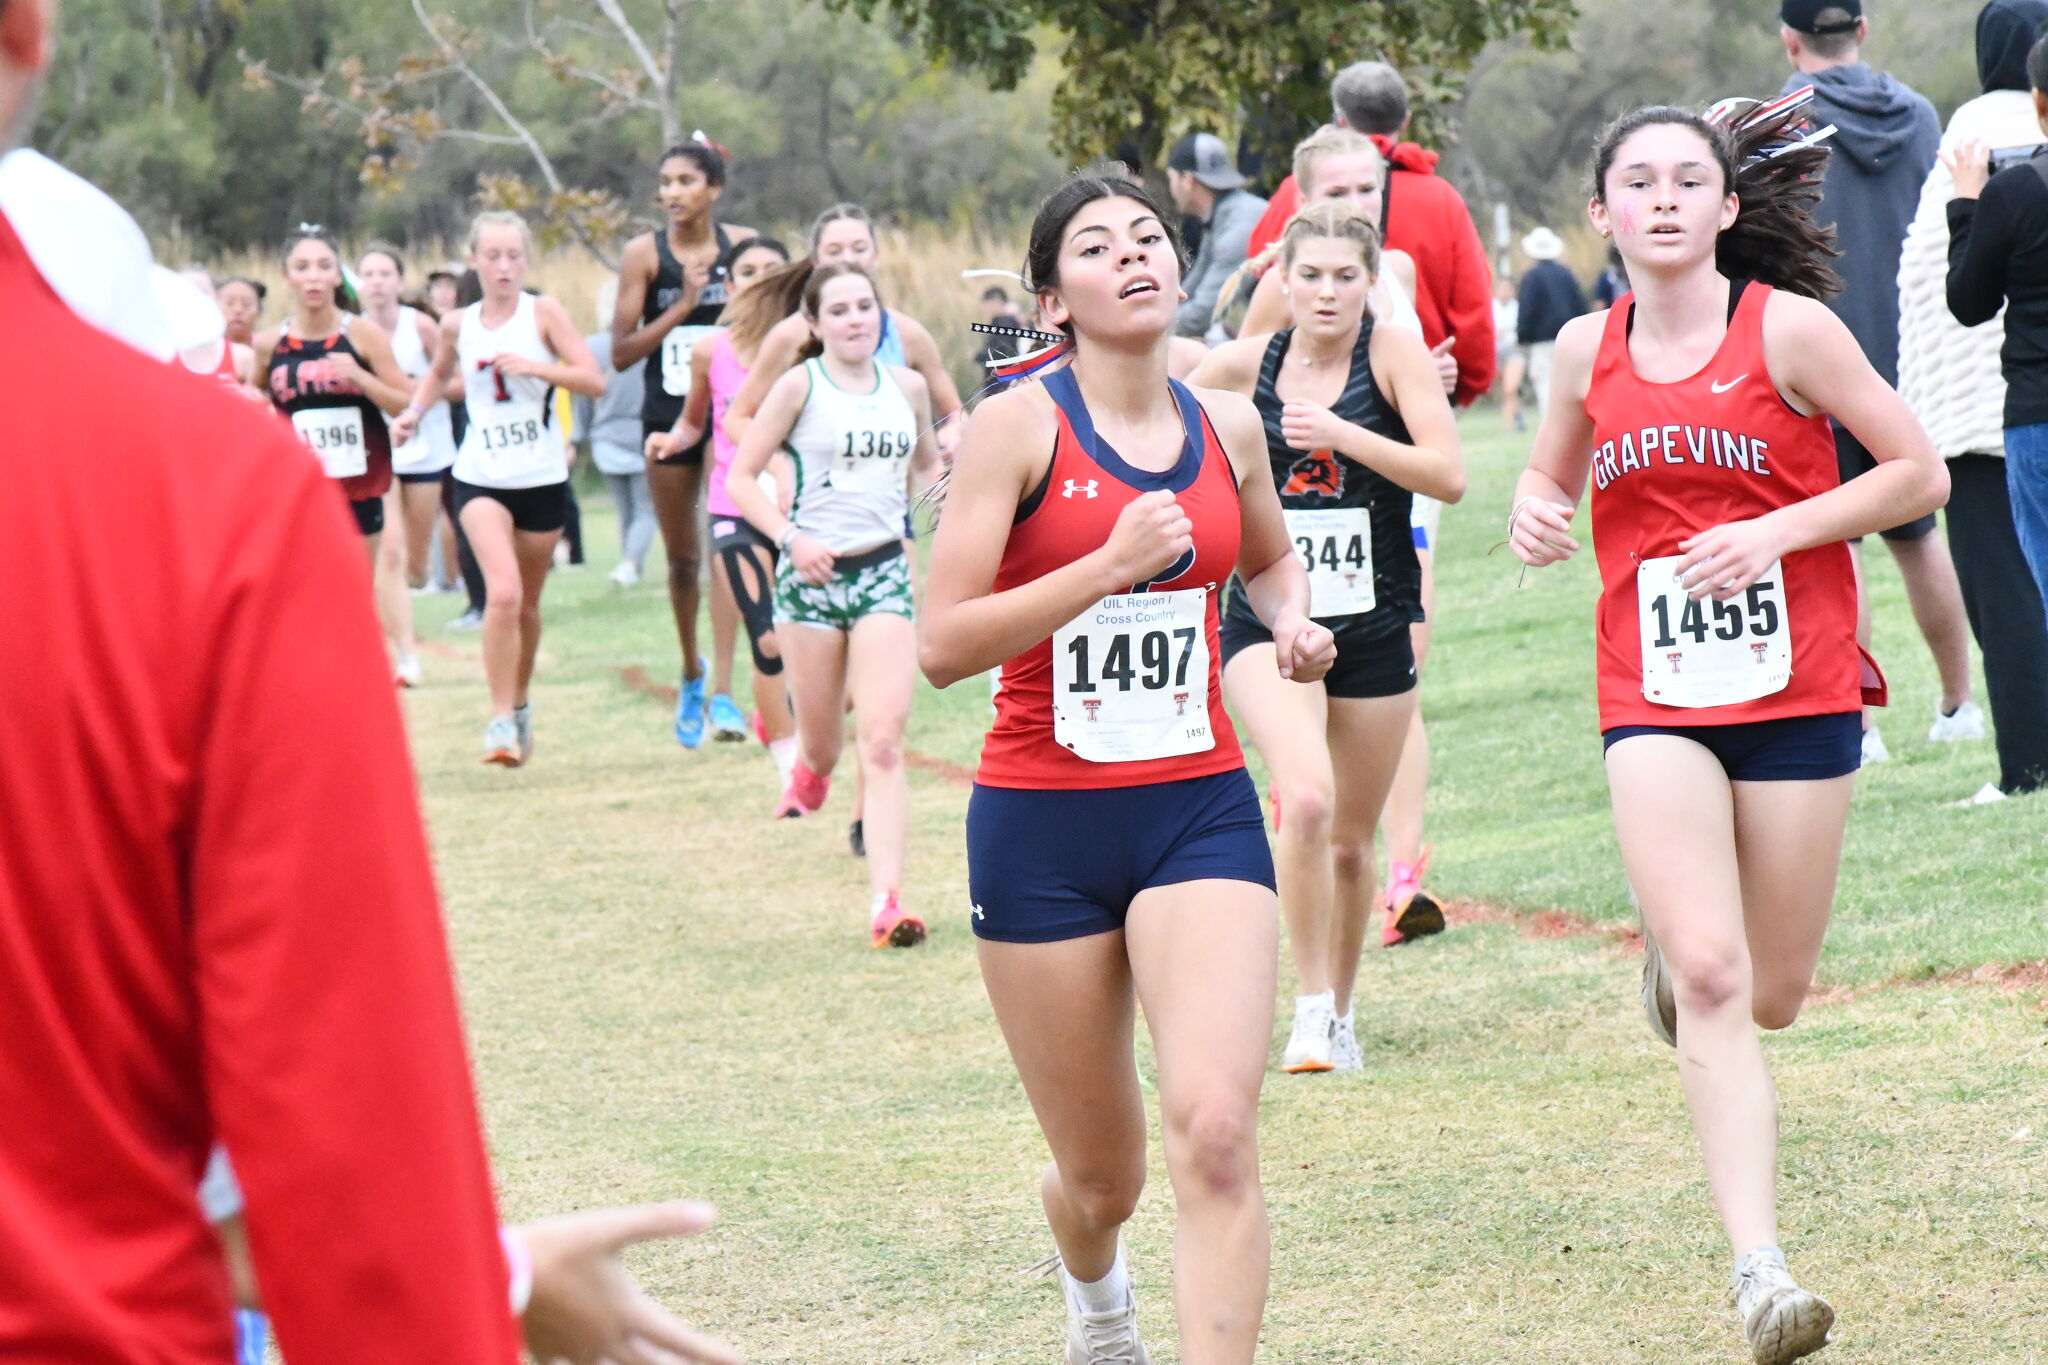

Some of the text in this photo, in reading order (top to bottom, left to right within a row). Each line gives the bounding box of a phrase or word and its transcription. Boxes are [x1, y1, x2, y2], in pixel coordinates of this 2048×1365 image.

[482, 419, 538, 449] 1358
[841, 430, 910, 458] 1369
[1593, 424, 1771, 491] GRAPEVINE
[1295, 534, 1366, 572] 344
[1096, 610, 1176, 625] Cross Country
[1103, 598, 1123, 609] UIL
[1127, 596, 1165, 609] Region
[1651, 581, 1779, 648] 1455
[1068, 626, 1196, 693] 1497
[1186, 727, 1206, 738] 1497
